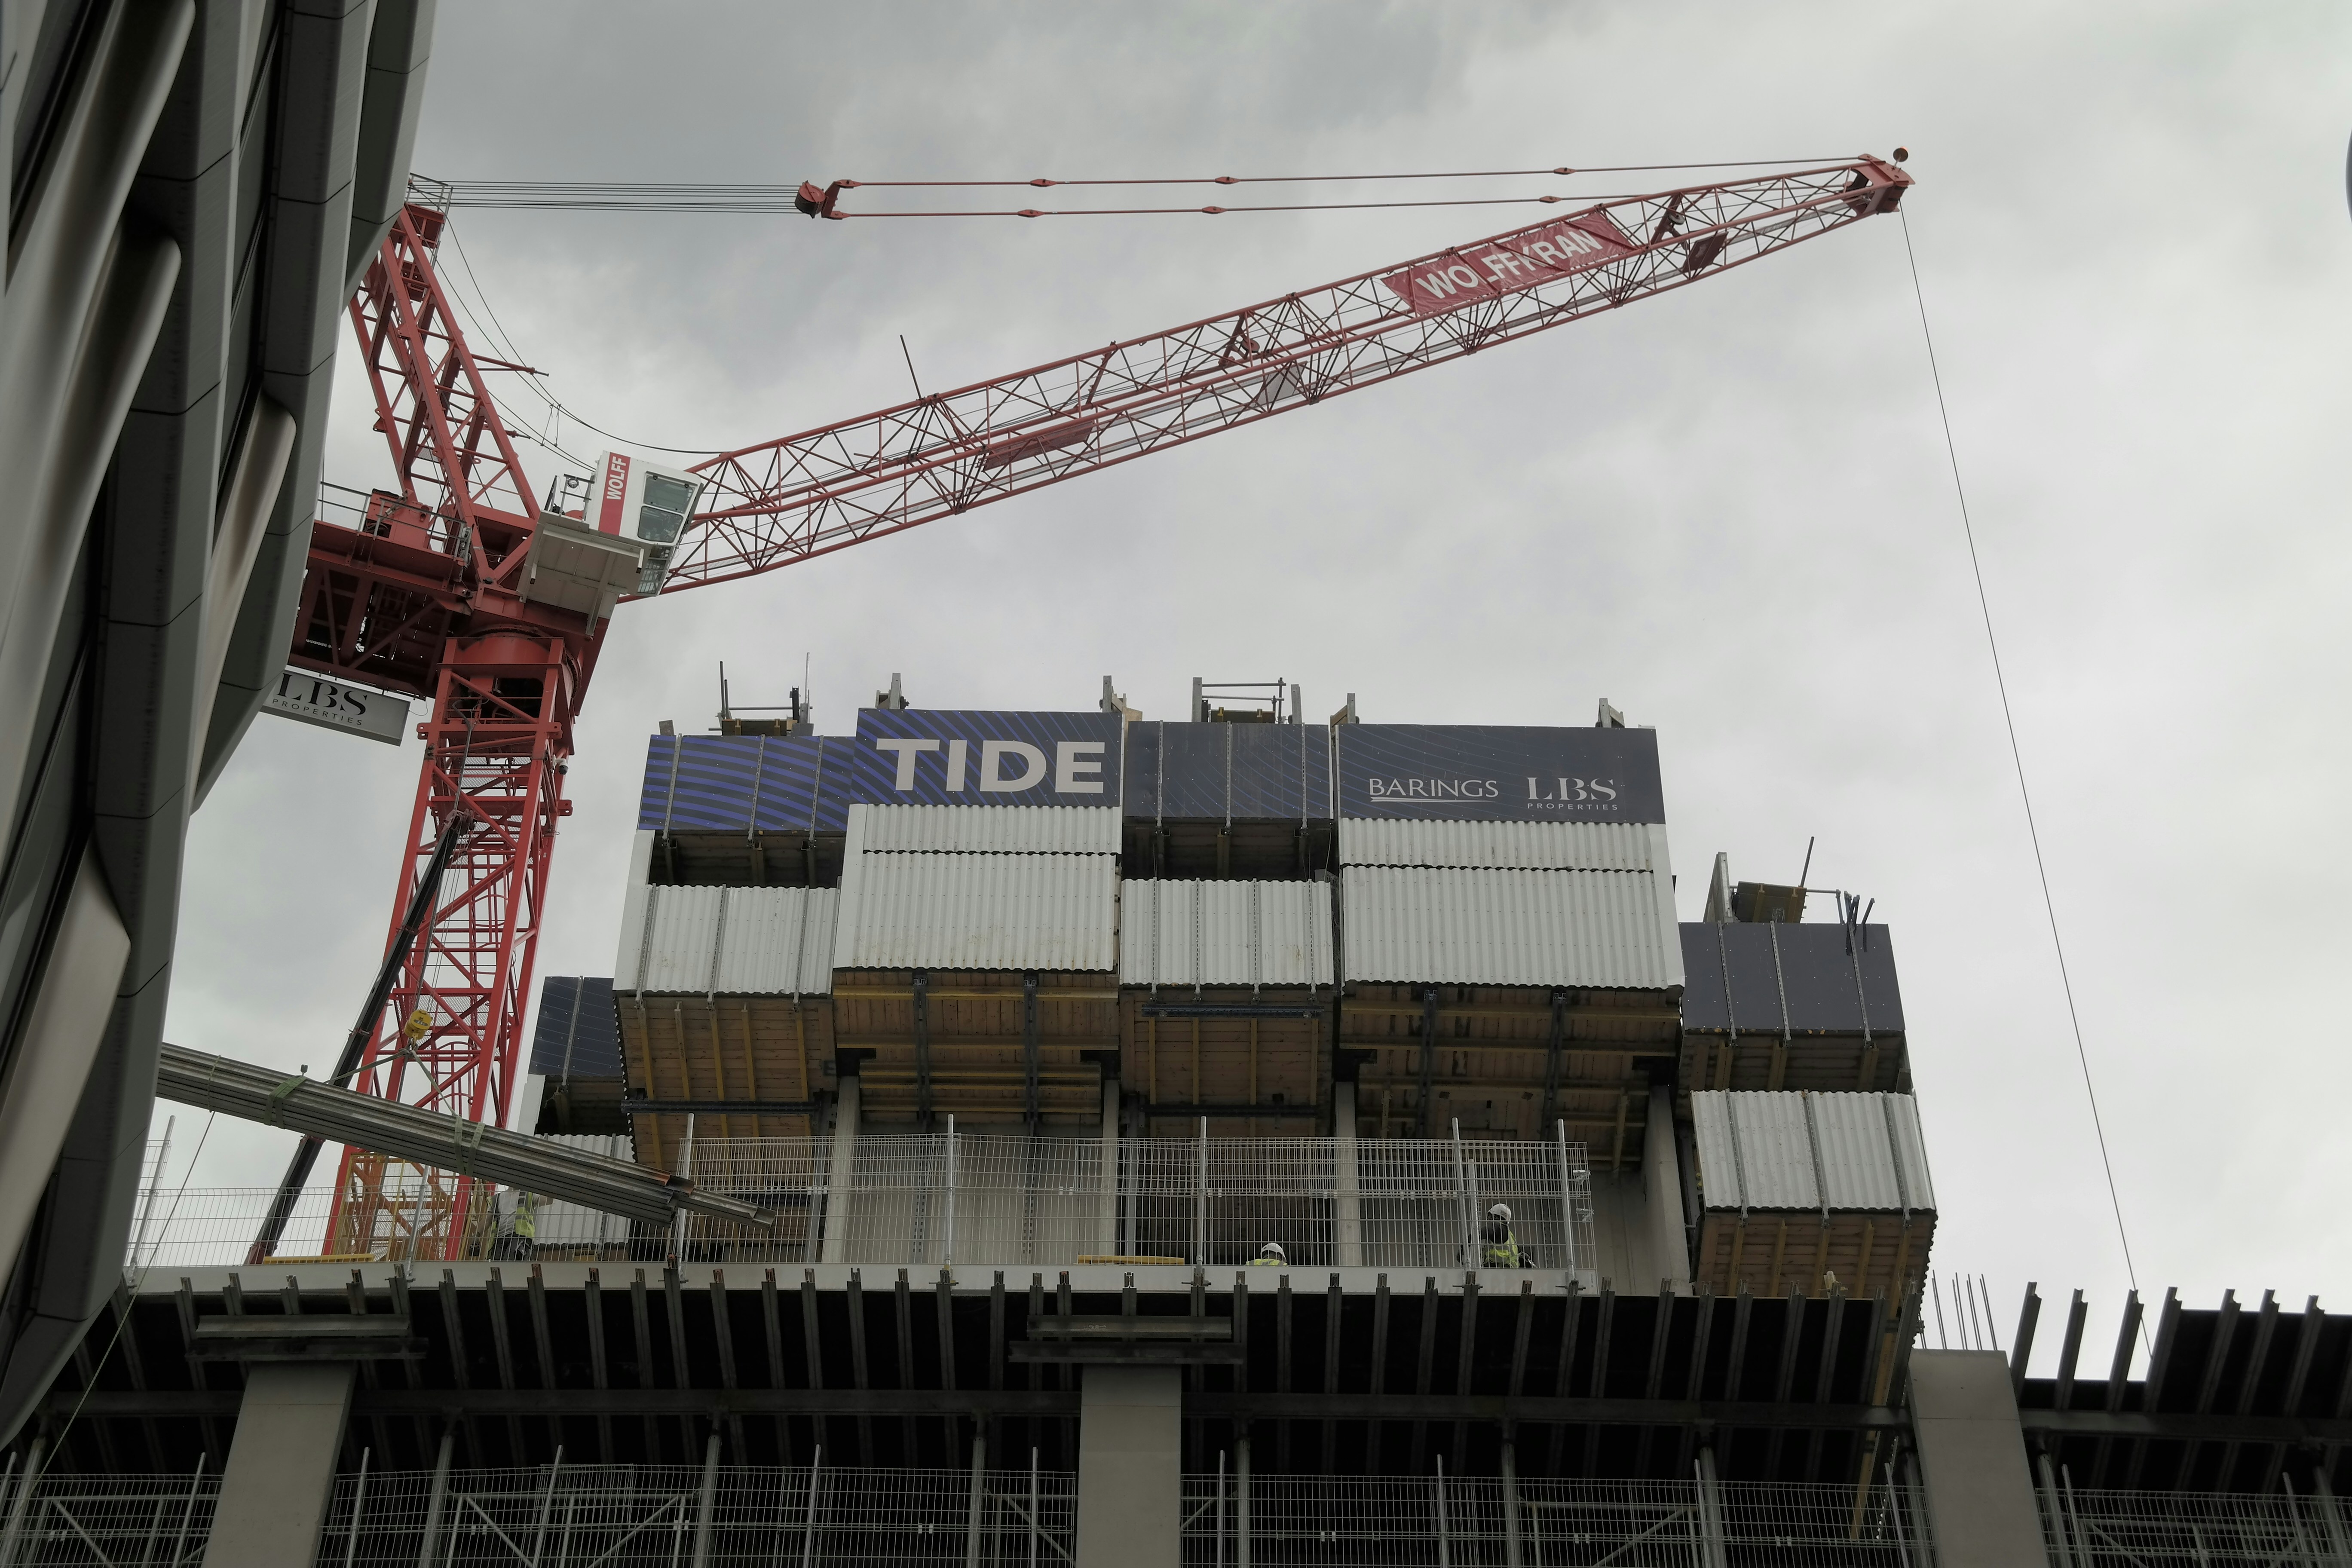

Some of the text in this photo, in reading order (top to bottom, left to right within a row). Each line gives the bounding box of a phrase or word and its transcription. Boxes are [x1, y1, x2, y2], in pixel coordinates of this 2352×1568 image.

[606, 456, 627, 500] WOLFF
[272, 698, 362, 726] PROPERTIES
[276, 672, 368, 716] LBS
[876, 738, 1106, 793] TIDE
[1369, 778, 1499, 798] BARINGS
[1526, 777, 1617, 801] LBS
